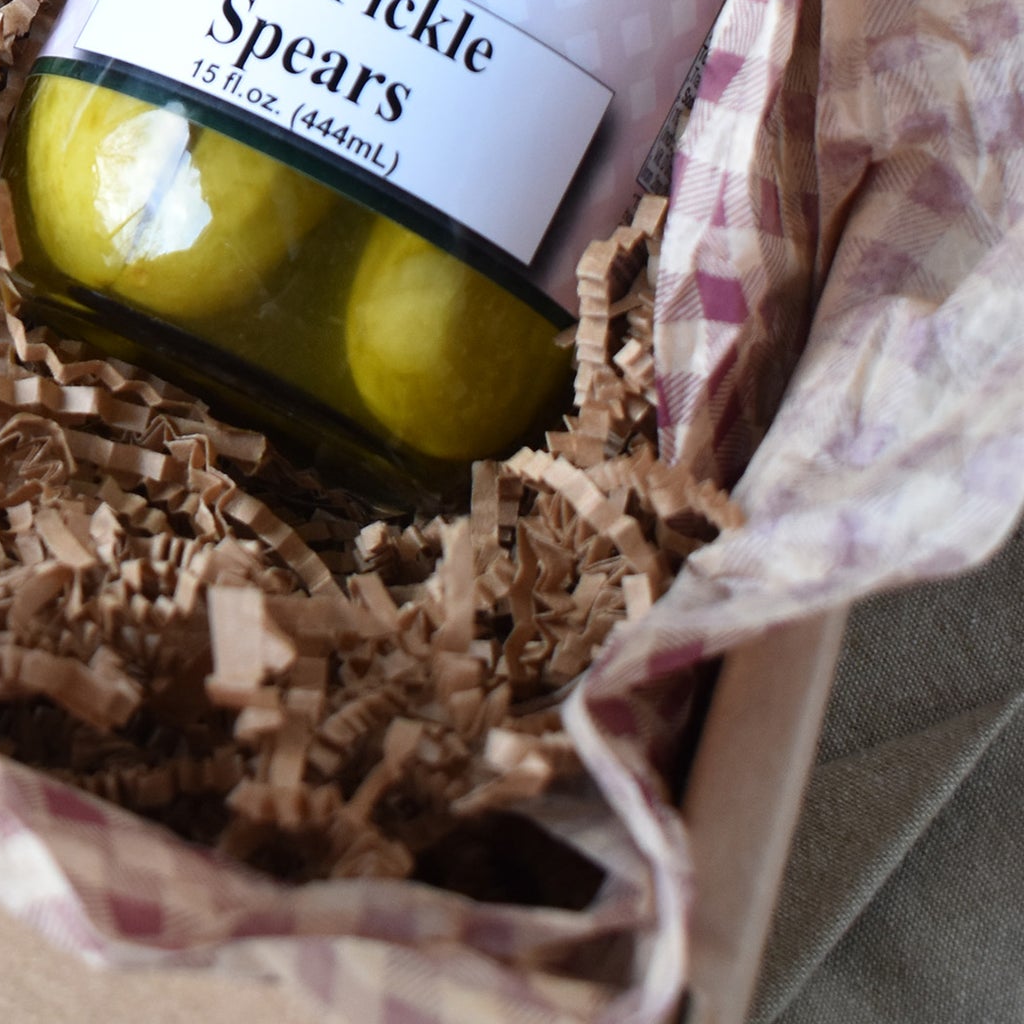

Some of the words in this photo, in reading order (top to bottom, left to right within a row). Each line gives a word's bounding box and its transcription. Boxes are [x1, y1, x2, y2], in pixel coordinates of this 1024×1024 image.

[191, 59, 220, 84] 15
[222, 71, 280, 114] fl.oz.
[290, 103, 400, 177] (444mL)
